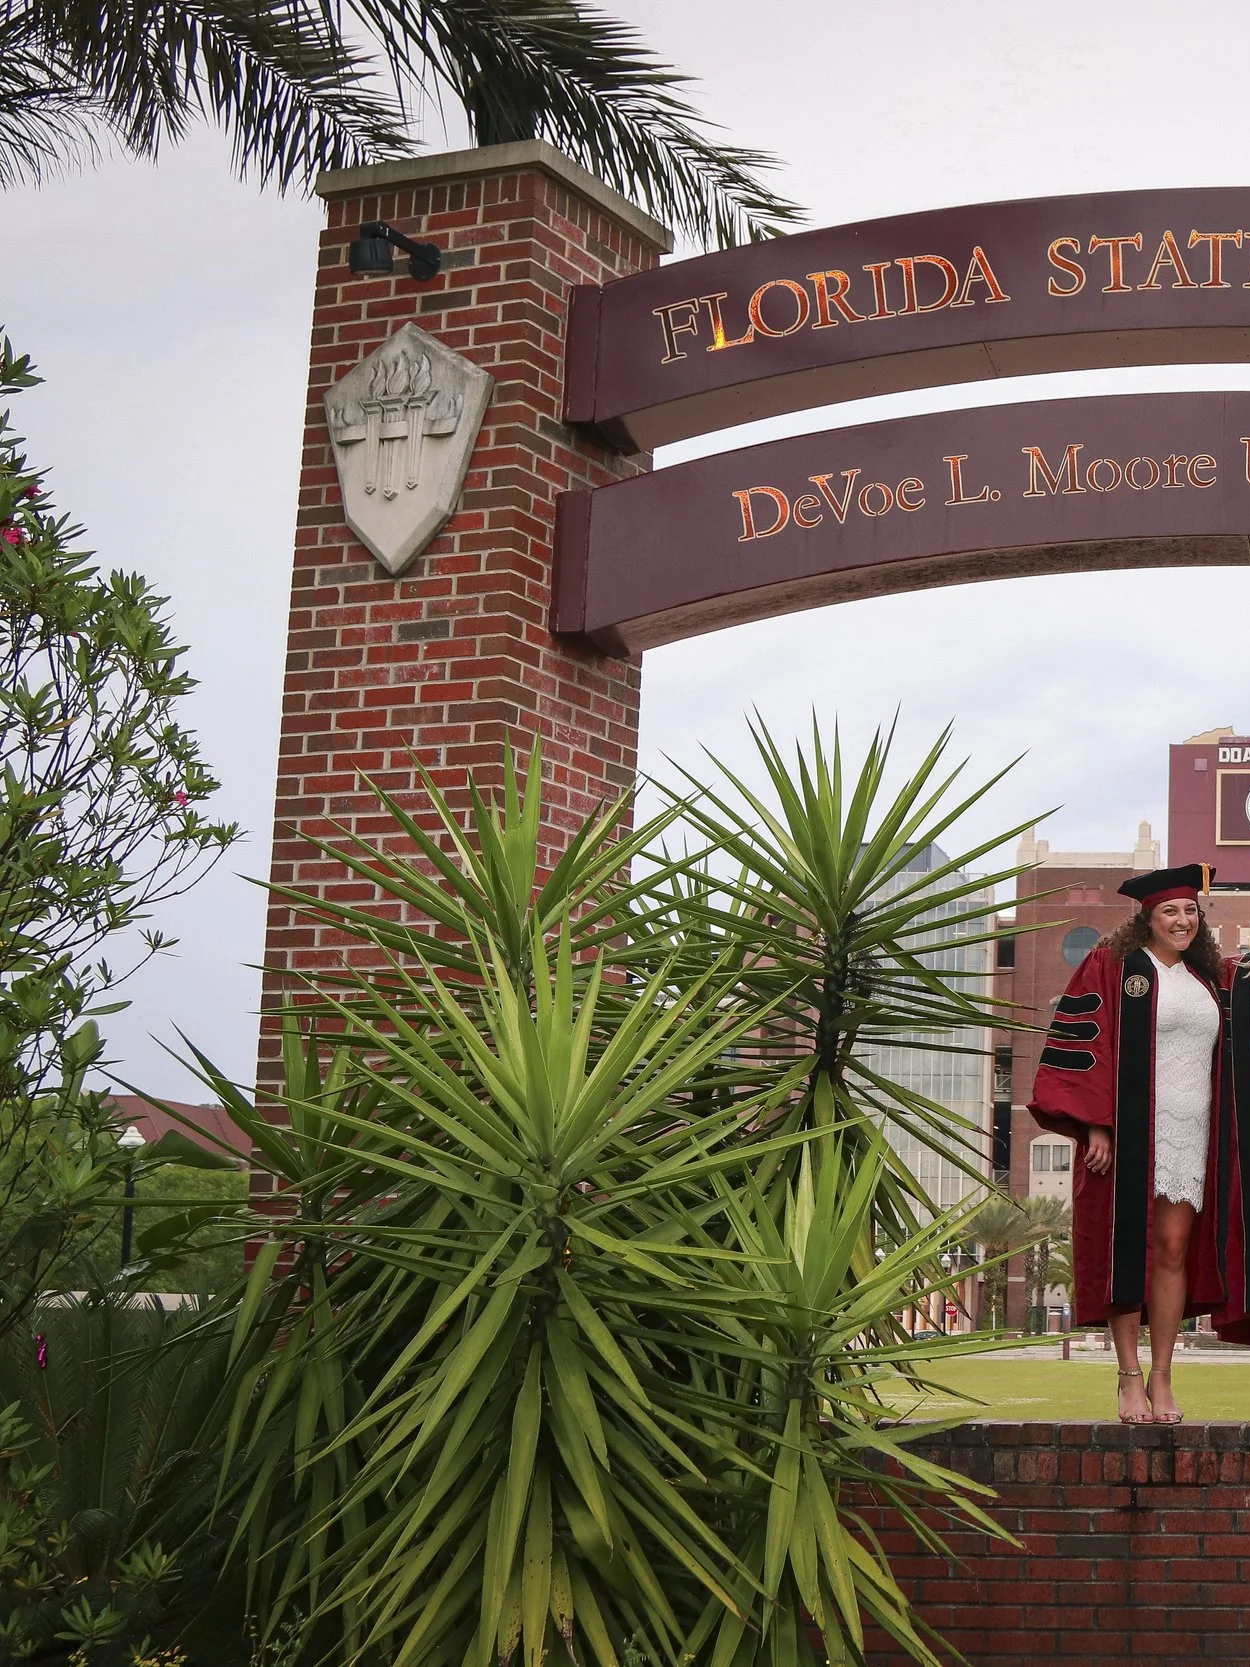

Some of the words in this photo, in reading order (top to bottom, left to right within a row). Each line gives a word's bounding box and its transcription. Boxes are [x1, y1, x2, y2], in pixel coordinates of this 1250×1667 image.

[652, 245, 1011, 364] FLORIDA
[732, 468, 926, 542] DeVoe
[943, 454, 1002, 506] L.
[1021, 443, 1218, 498] Moore
